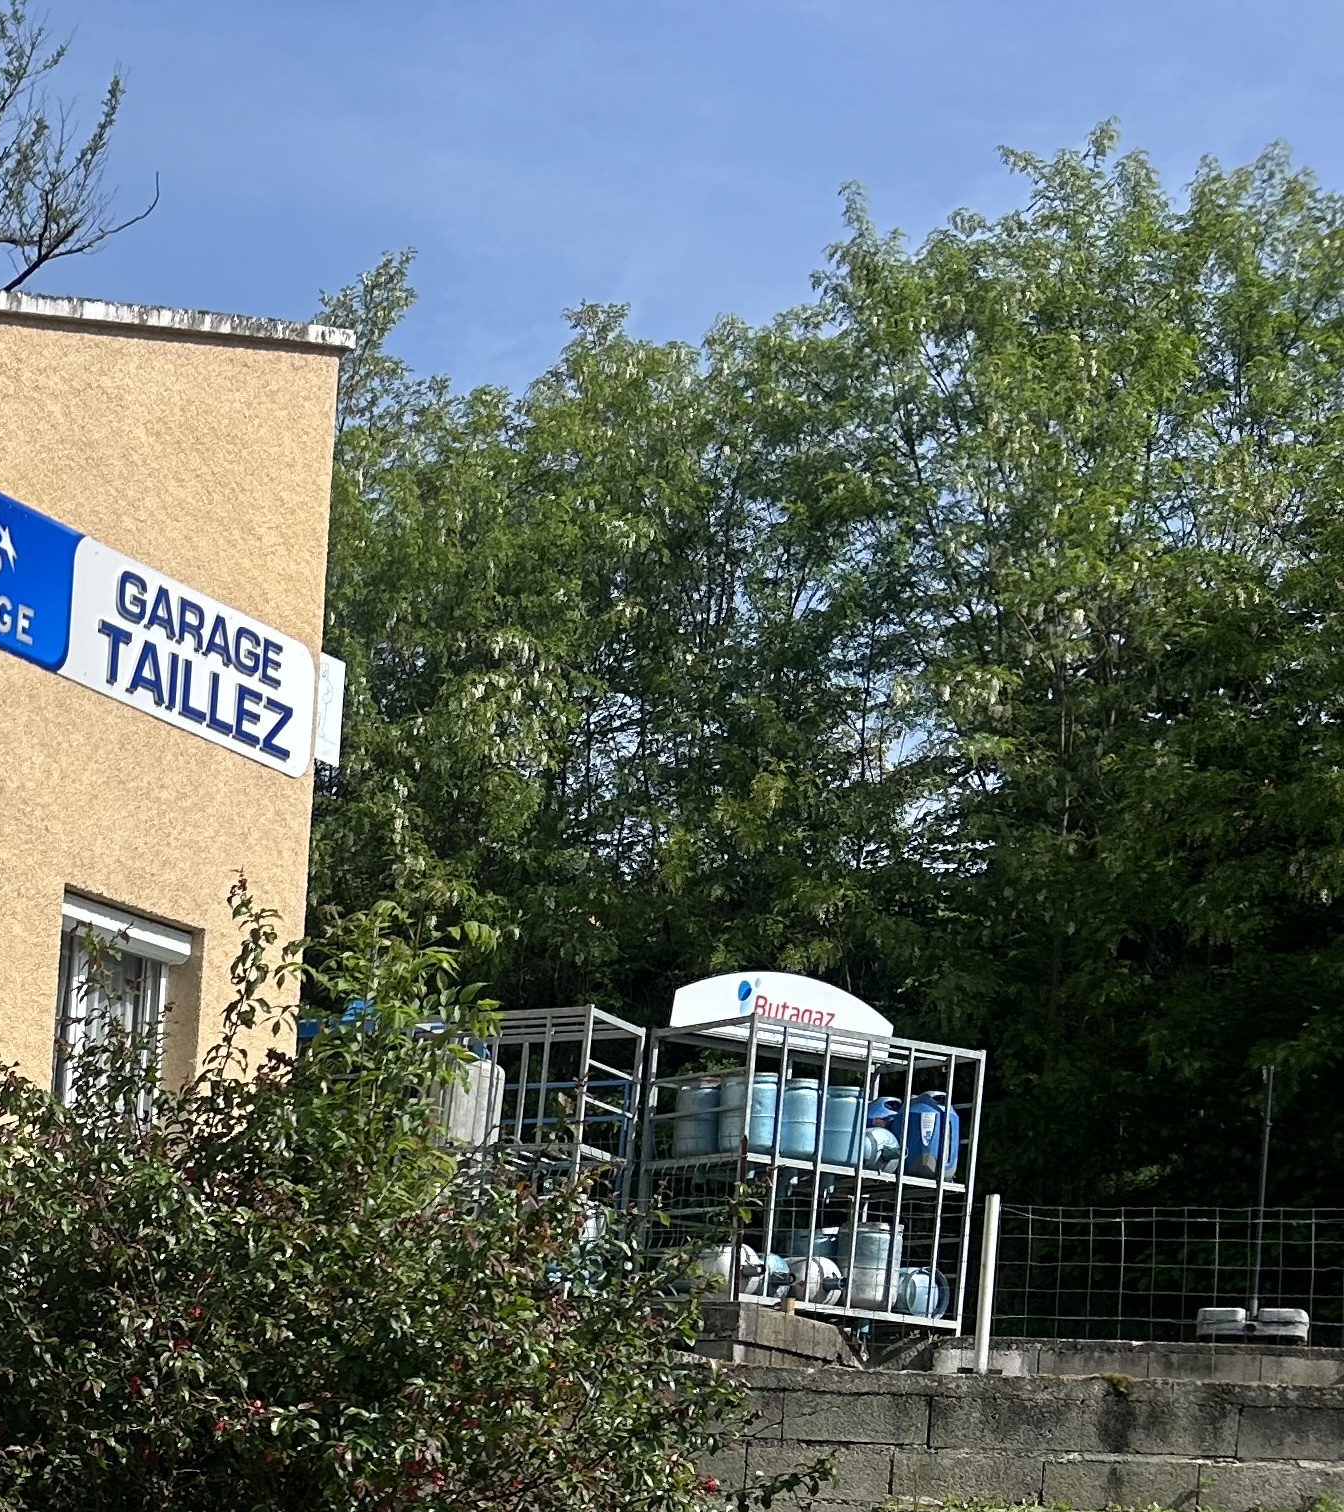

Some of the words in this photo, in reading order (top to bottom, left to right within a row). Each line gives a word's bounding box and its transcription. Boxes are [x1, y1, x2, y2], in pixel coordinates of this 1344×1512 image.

[115, 570, 283, 689] GARAGE
[98, 618, 293, 761] TAILLEZ
[754, 995, 836, 1027] Butagaz
